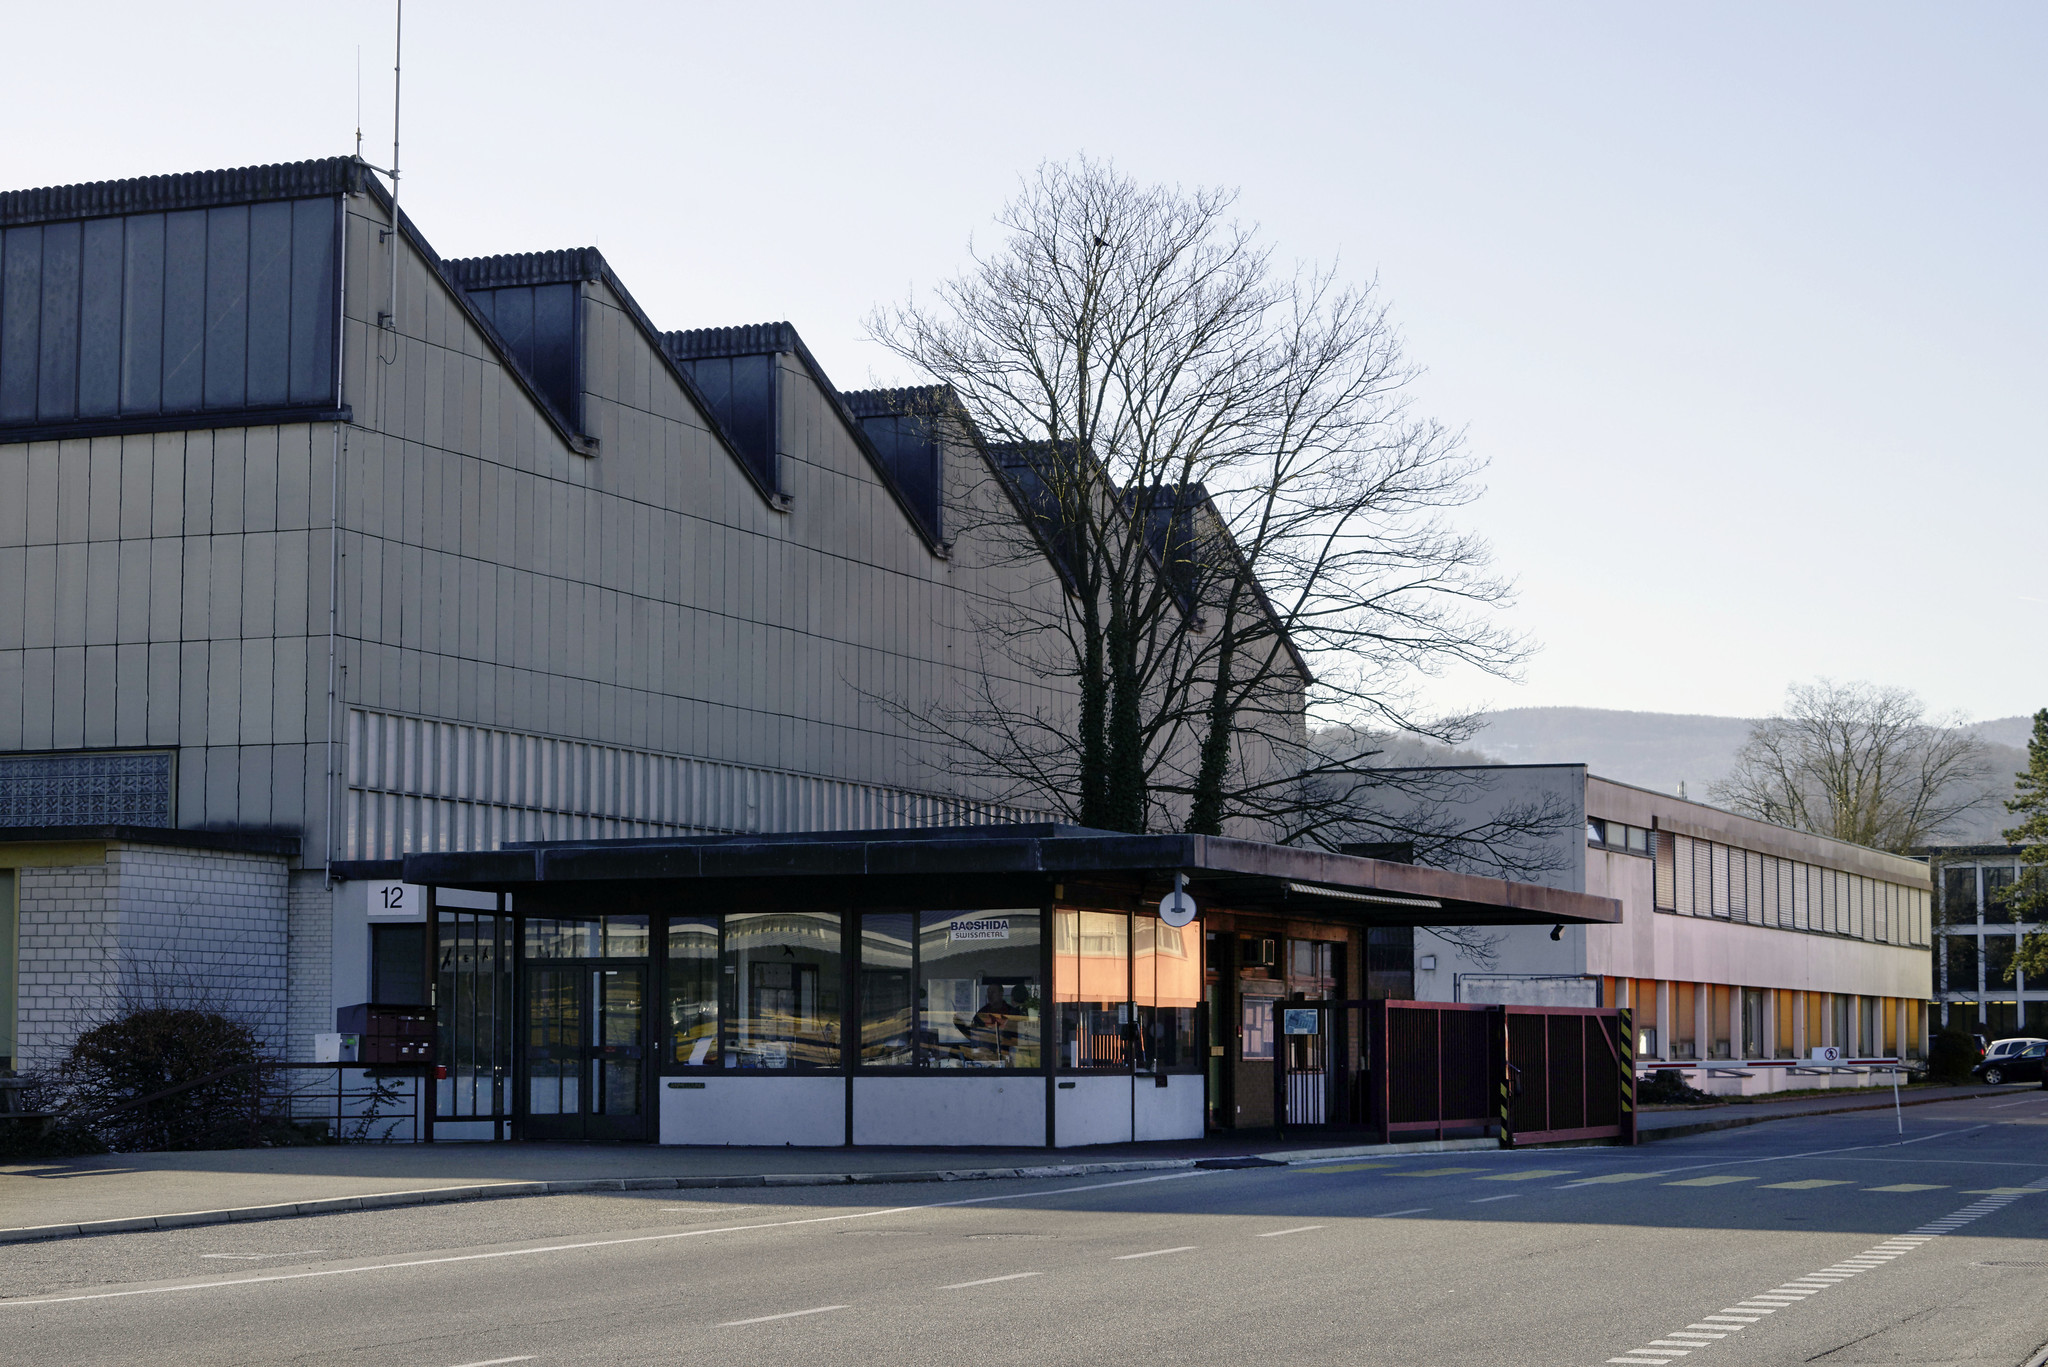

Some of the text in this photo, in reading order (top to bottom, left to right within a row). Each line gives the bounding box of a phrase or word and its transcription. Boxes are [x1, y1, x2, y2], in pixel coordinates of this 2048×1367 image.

[380, 886, 404, 909] 12
[950, 920, 1009, 931] BAOSHIDA
[955, 931, 1004, 939] SWISSMETAL
